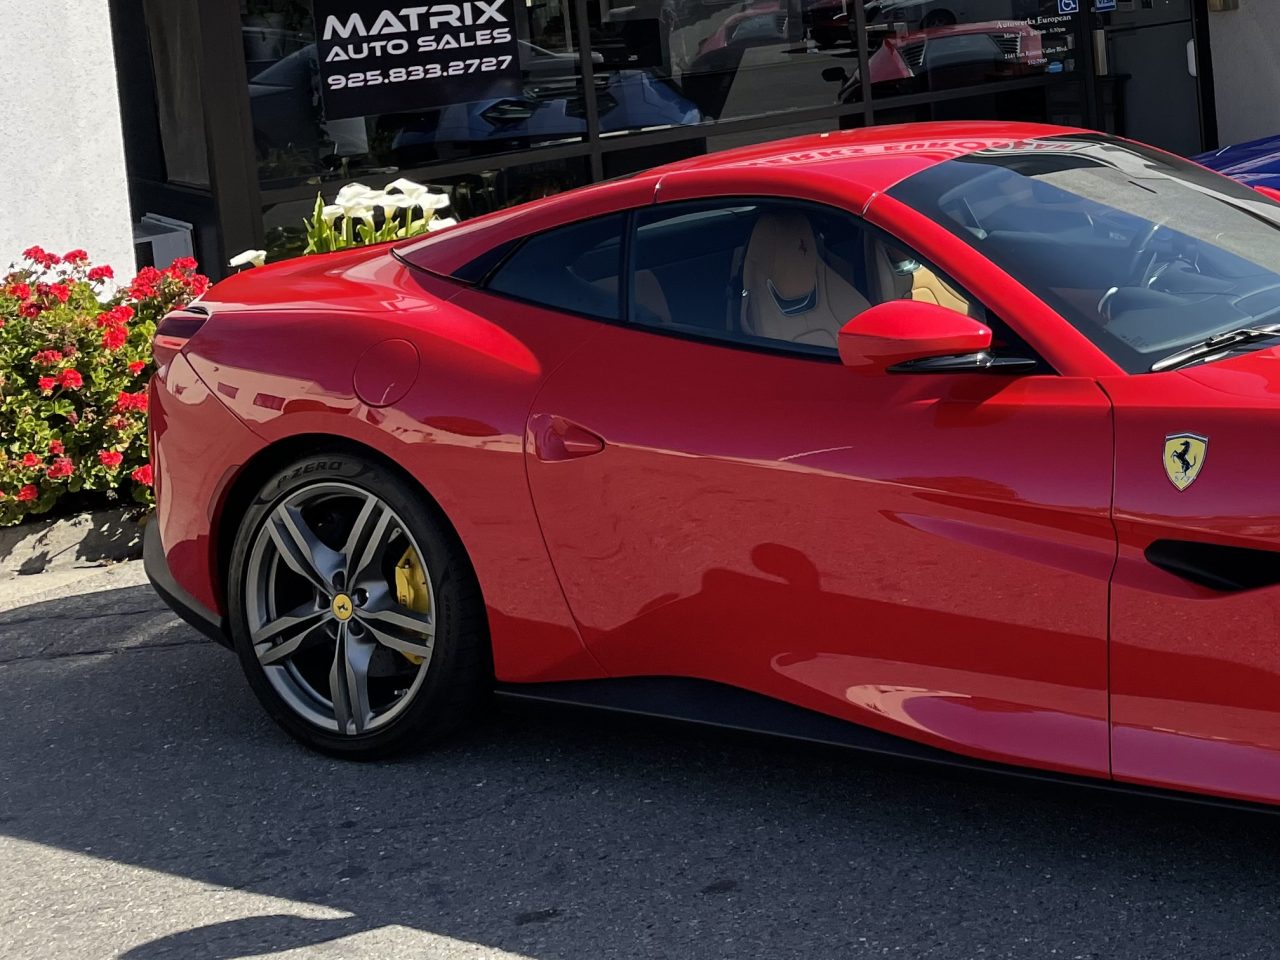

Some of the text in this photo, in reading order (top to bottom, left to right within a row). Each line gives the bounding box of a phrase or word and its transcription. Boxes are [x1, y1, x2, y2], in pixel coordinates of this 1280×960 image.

[996, 14, 1072, 29] Autowerks European
[325, 27, 512, 63] AUTO SALES
[327, 55, 513, 90] 925.833.2727
[291, 461, 343, 479] ZERO
